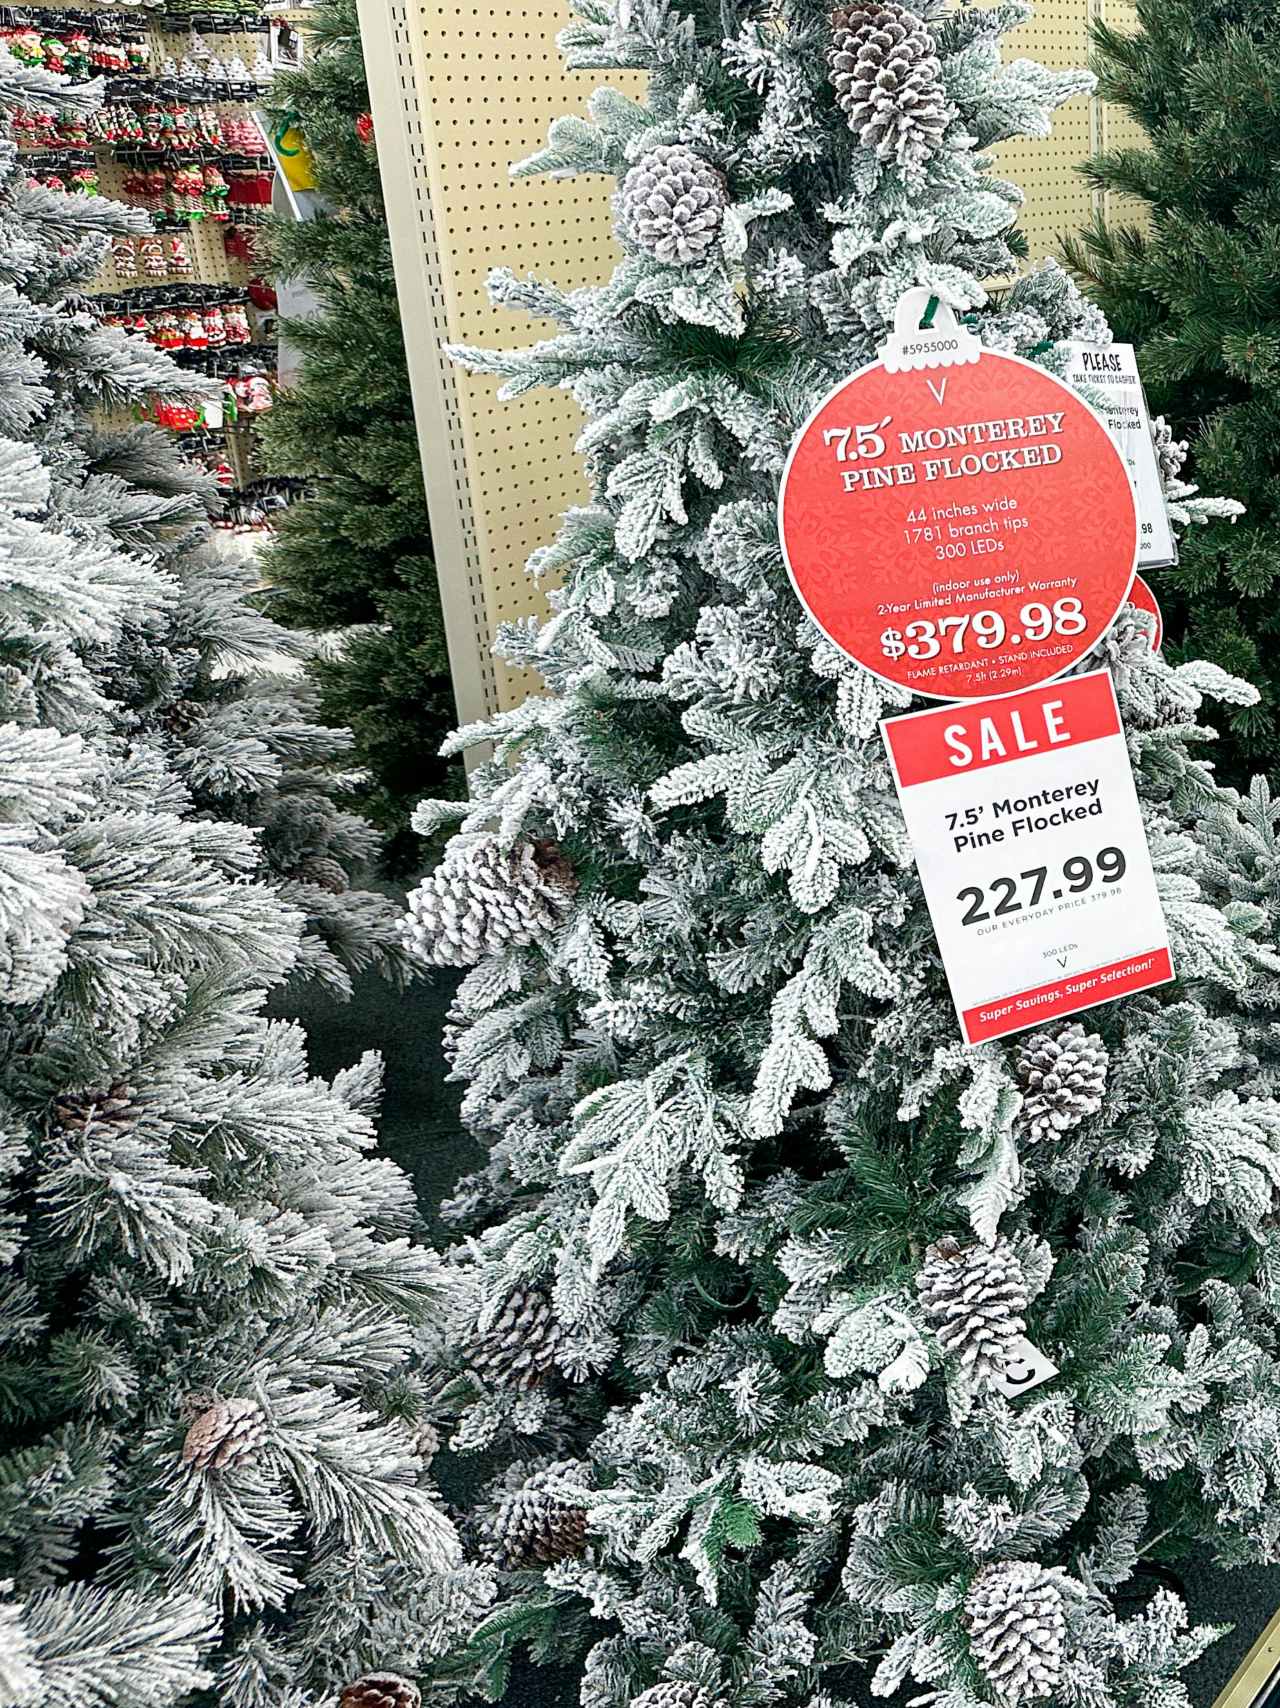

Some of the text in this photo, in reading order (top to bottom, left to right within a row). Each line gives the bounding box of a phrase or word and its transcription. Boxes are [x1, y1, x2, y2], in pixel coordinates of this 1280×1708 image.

[902, 340, 959, 356] #5955000
[1082, 353, 1122, 372] PLEASE
[926, 377, 947, 406] V
[1072, 373, 1087, 383] TAKE
[1107, 374, 1115, 384] TO
[899, 412, 1065, 453] MONTEREY
[841, 444, 1062, 493] PINE FLOCKED
[907, 496, 1018, 523] 44 inches wide
[904, 516, 1029, 545] 1781 branch tips
[935, 538, 1005, 560] 300 LEDs
[877, 576, 1077, 616] 2-Year Limited Manufacturer Warranty
[932, 570, 1020, 595] (indoor use only)
[880, 597, 1088, 661] $379.98
[907, 644, 1073, 680] FLAME RETARDANT STAND INCLUDED
[943, 700, 1071, 767] SALE
[993, 778, 1100, 820] Monterey
[953, 799, 1103, 852] Pine Flocked
[956, 846, 1127, 926] 227.99
[977, 923, 999, 937] OUR
[1002, 907, 1054, 930] EVERYDAY
[1058, 898, 1087, 913] PRICE
[979, 1004, 1013, 1023] Super
[1015, 989, 1064, 1012] Savings,
[1065, 977, 1098, 996] Super
